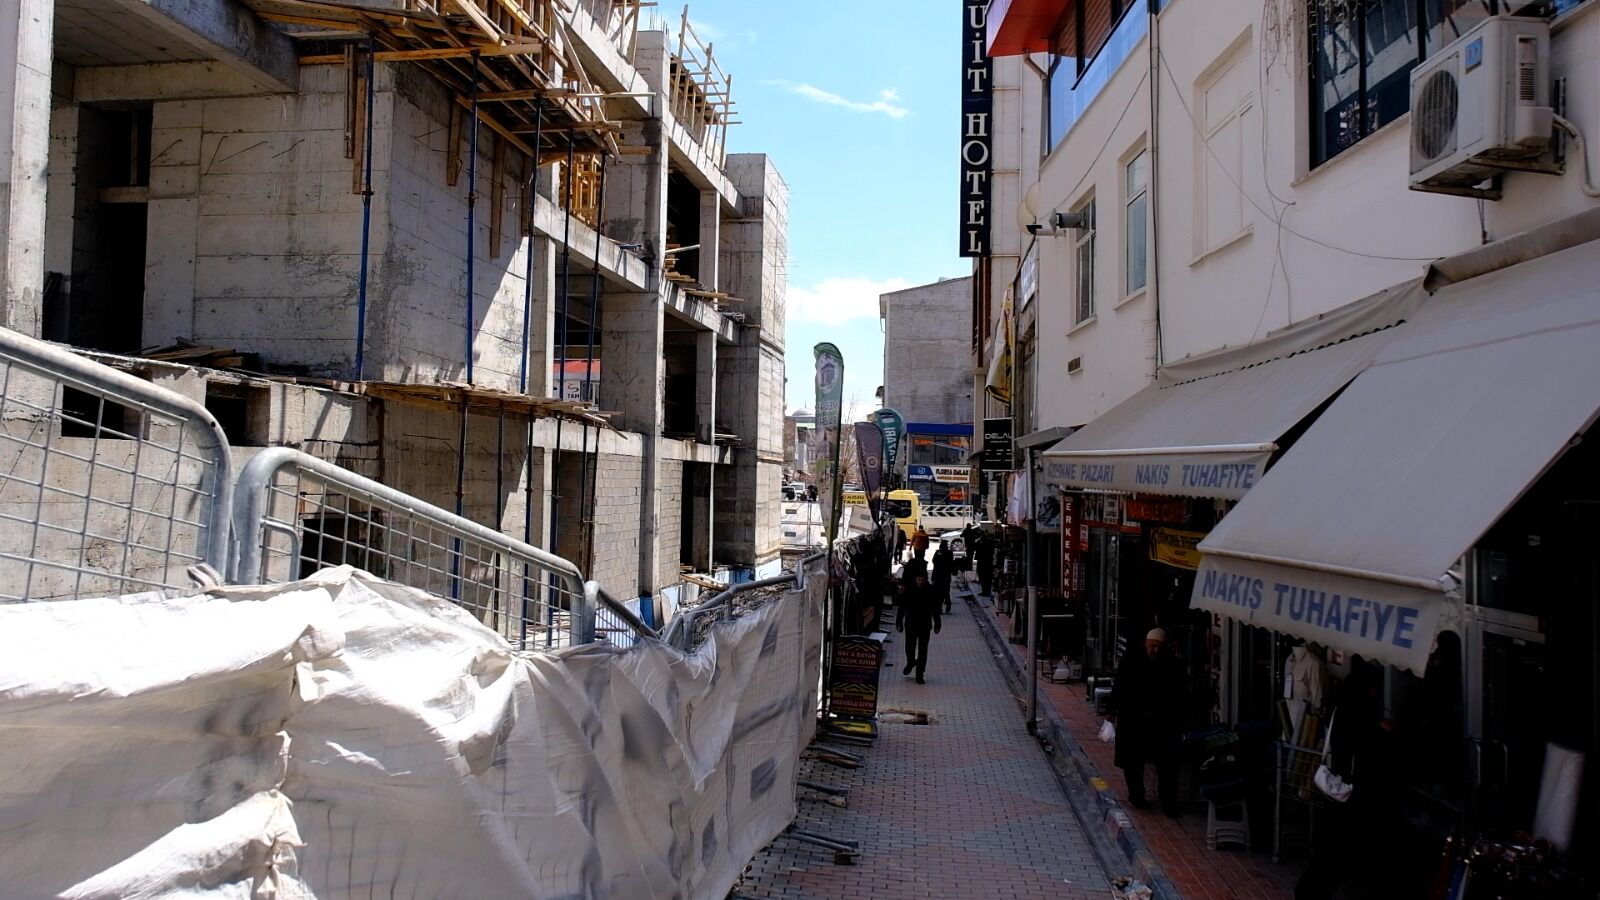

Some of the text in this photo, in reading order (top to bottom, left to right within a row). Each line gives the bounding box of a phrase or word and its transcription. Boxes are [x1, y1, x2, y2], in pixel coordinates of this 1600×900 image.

[963, 0, 989, 254] UİT HOTEL
[1080, 464, 1115, 483] PAZARI
[1135, 464, 1171, 488] NAKIŞ
[1182, 463, 1257, 489] TUHAFİYE
[1064, 502, 1072, 562] ERKEK
[1202, 569, 1419, 650] NAKIŞ TUHAFİYE
